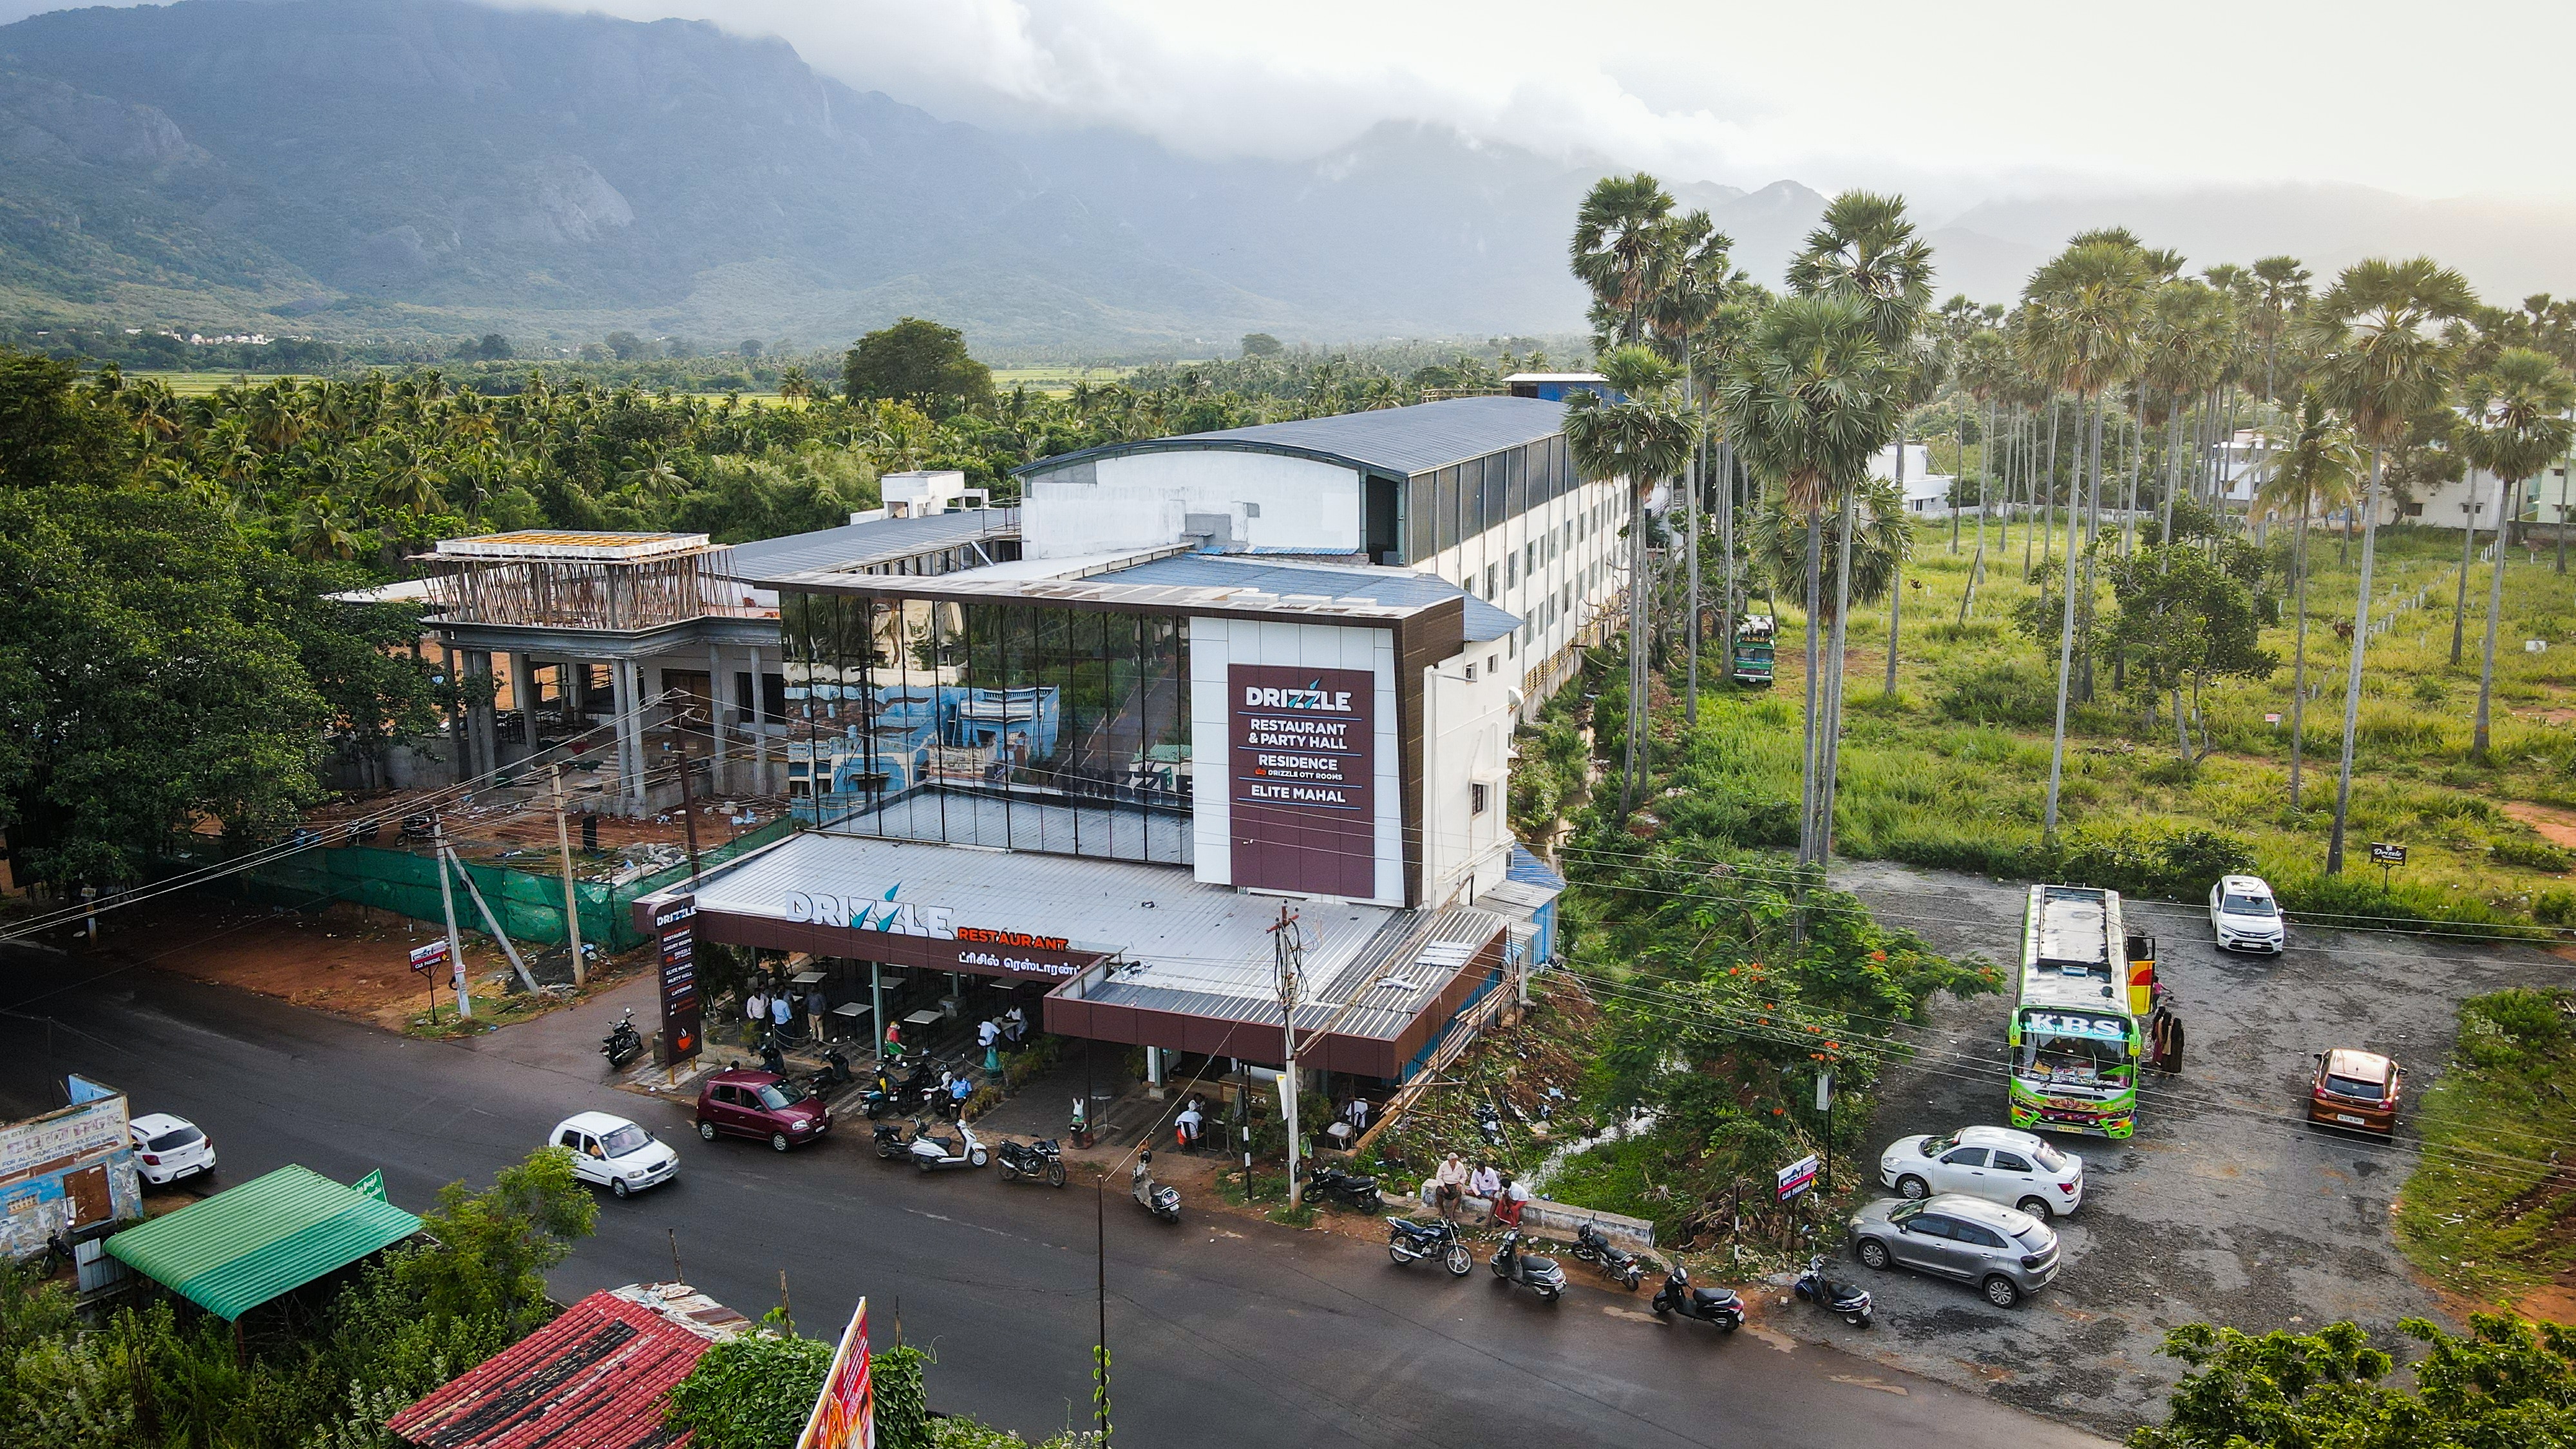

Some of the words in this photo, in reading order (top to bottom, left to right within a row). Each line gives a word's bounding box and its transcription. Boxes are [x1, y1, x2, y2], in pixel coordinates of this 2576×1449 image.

[1246, 687, 1352, 712] DRIZZLE
[1251, 718, 1347, 735] RESTAURANT
[1248, 732, 1258, 744] &
[1260, 733, 1307, 747] PARTY
[1309, 736, 1348, 750] HALL
[1258, 754, 1338, 771] RESIDENCE
[1267, 770, 1298, 778] DRIZZLE
[1251, 784, 1290, 799] ELITE
[1293, 788, 1346, 803] MAHAL
[656, 905, 697, 927] DRIZZLE
[785, 889, 955, 941] DRIZZLE
[958, 927, 1068, 951] RESTAURANT
[2029, 1012, 2121, 1037] KBS
